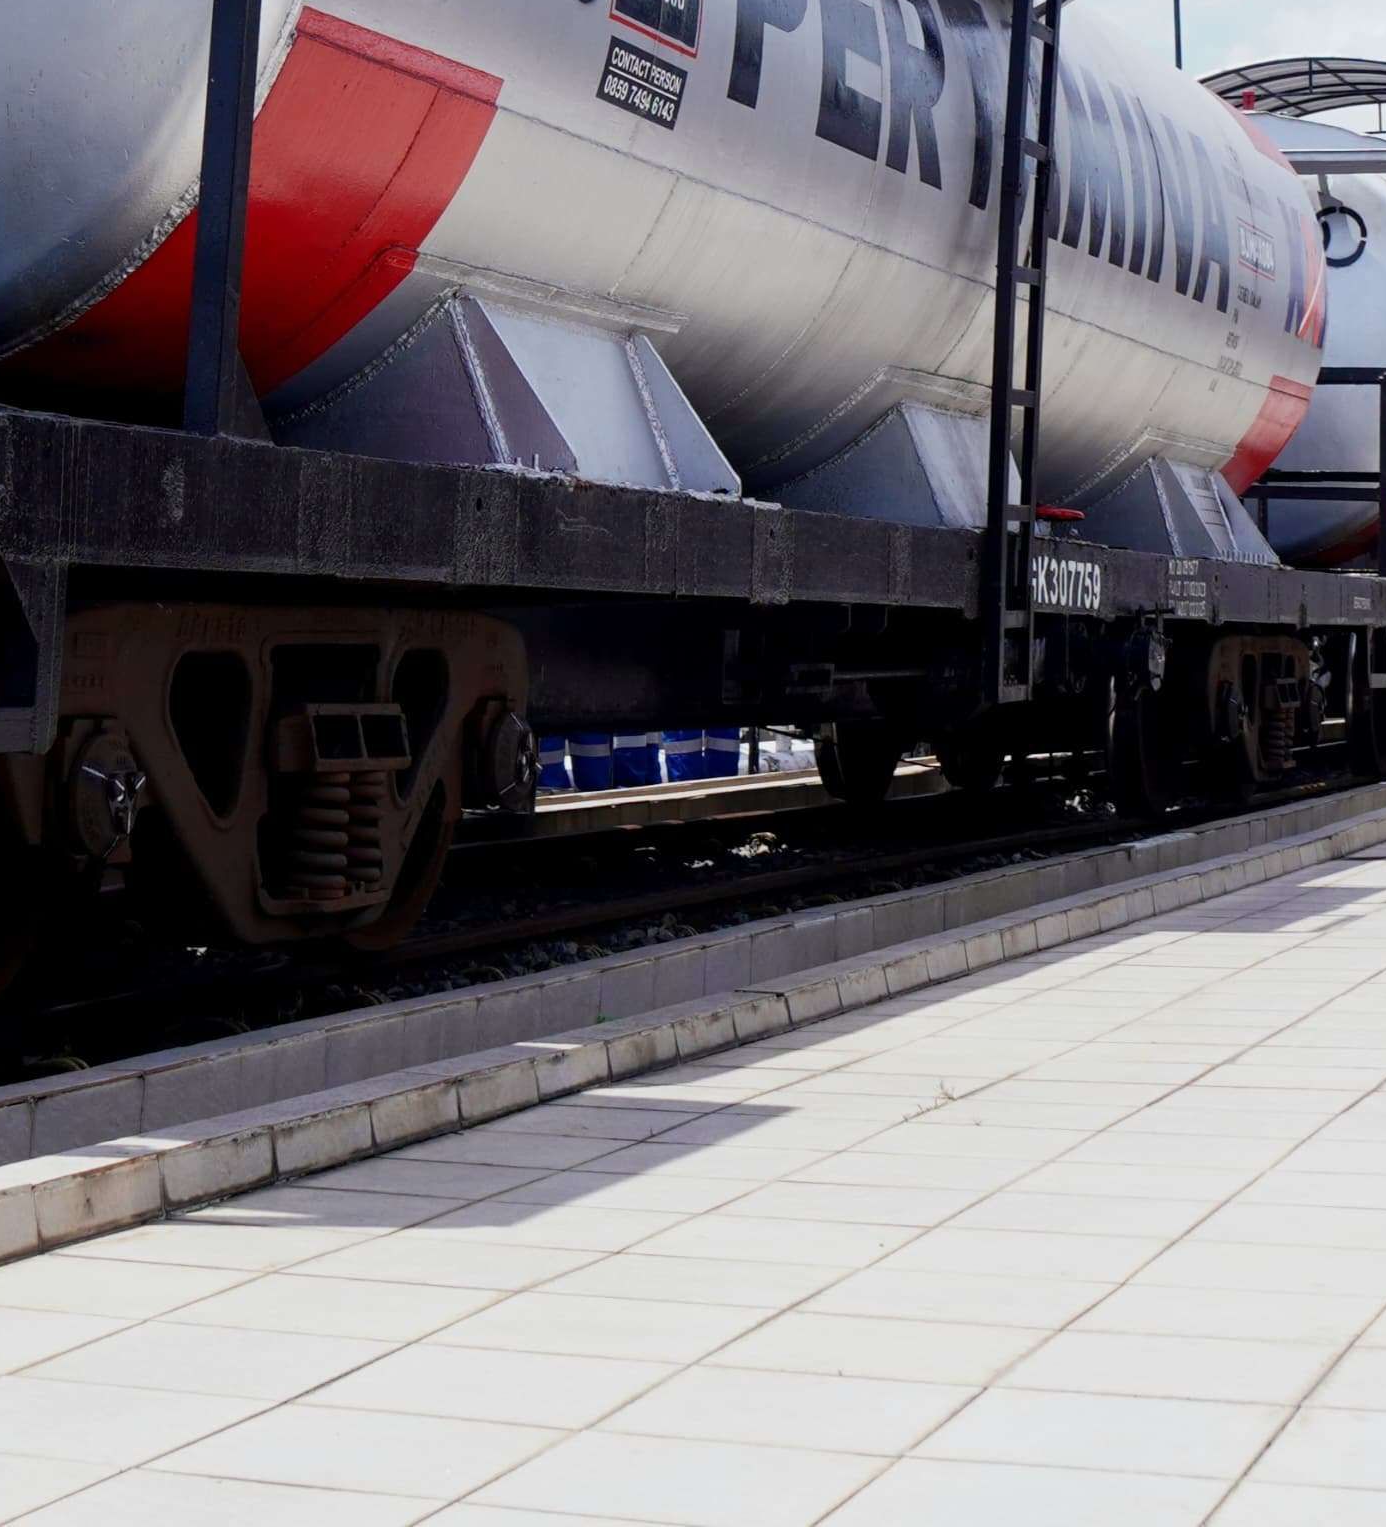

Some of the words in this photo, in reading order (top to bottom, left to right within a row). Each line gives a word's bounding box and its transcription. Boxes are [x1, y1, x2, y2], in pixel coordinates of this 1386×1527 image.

[611, 47, 650, 77] CONTACT
[650, 60, 682, 94] PERSON
[603, 74, 628, 100] 0859
[628, 84, 651, 112] 7494
[651, 94, 675, 122] 6143
